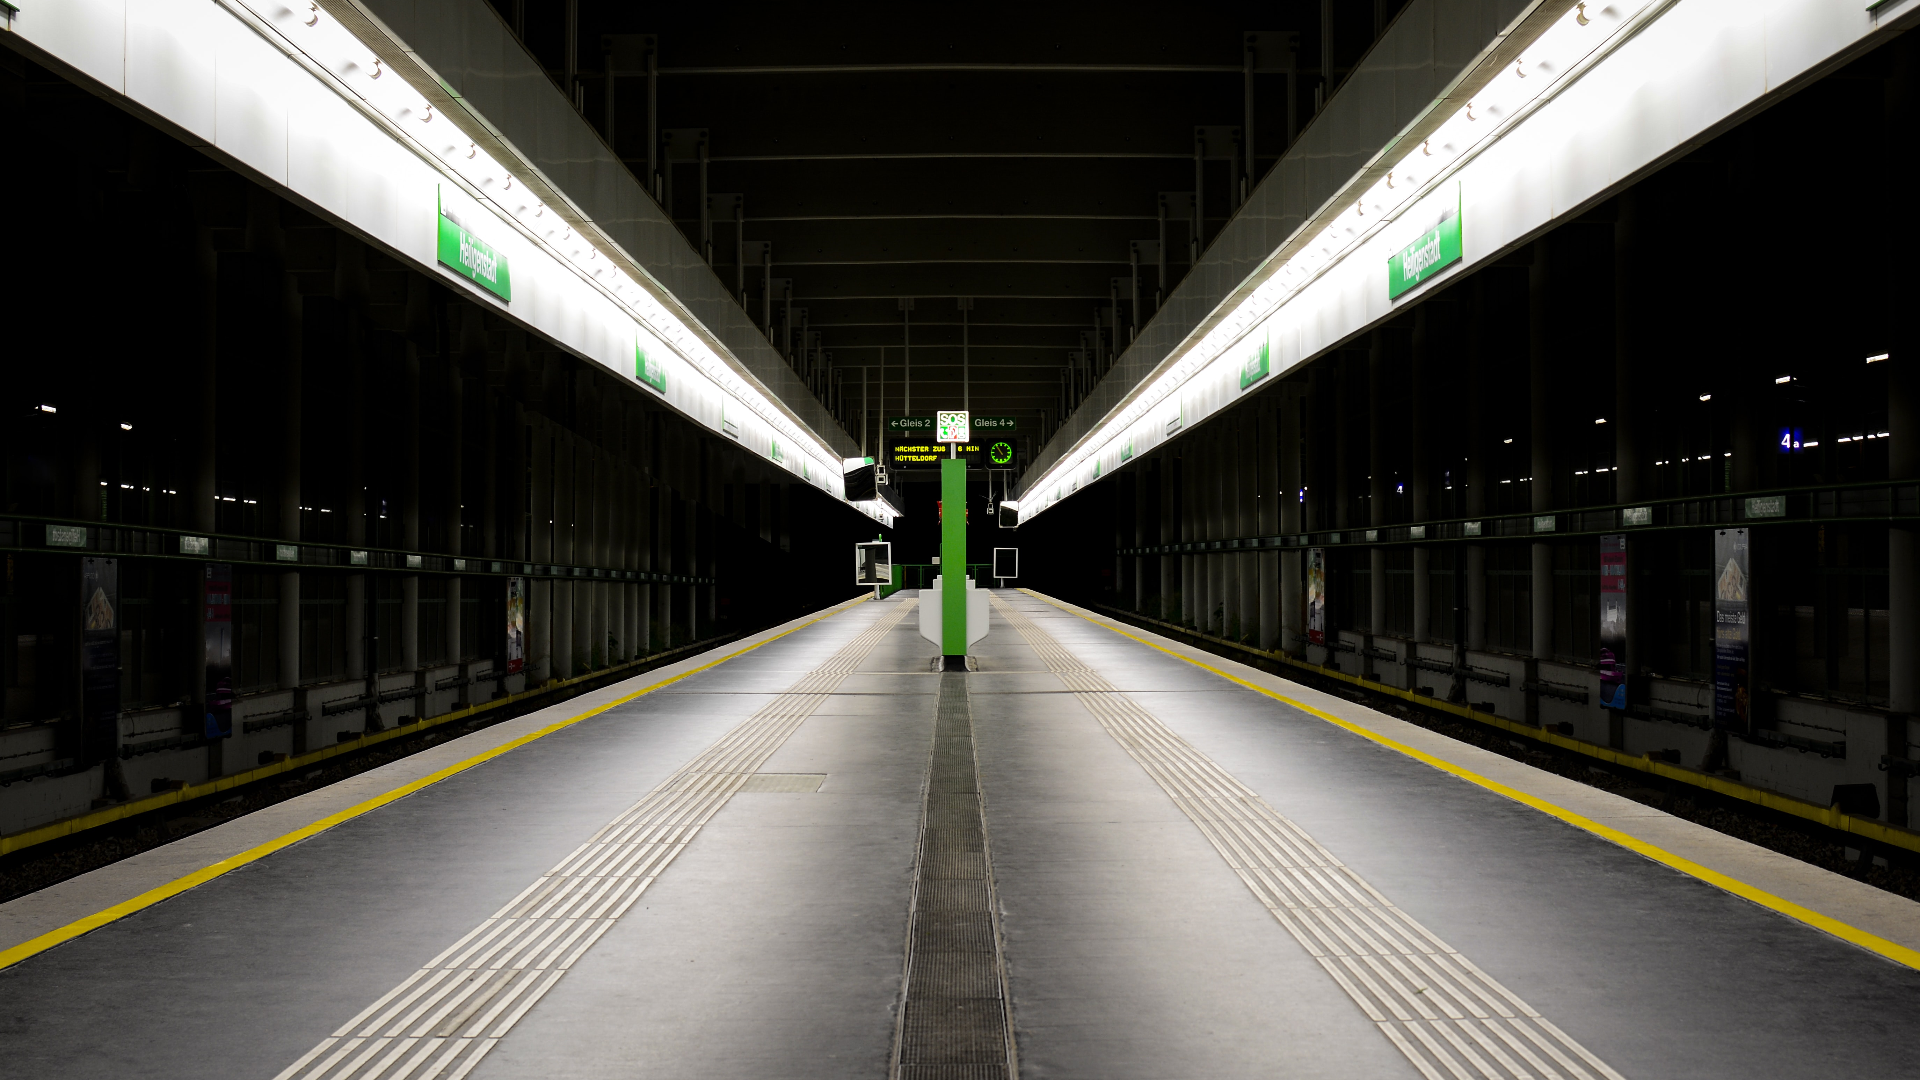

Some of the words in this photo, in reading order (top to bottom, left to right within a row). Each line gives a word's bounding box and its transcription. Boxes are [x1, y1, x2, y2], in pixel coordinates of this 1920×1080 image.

[459, 231, 497, 284] Heiligenstadt
[1402, 229, 1441, 281] Heiligenstadt
[899, 419, 922, 428] Gleis
[924, 419, 931, 427] 2
[940, 414, 966, 426] SOS
[974, 418, 997, 427] Gleis
[999, 418, 1006, 427] 4
[894, 454, 937, 462] HÜTTELDORF
